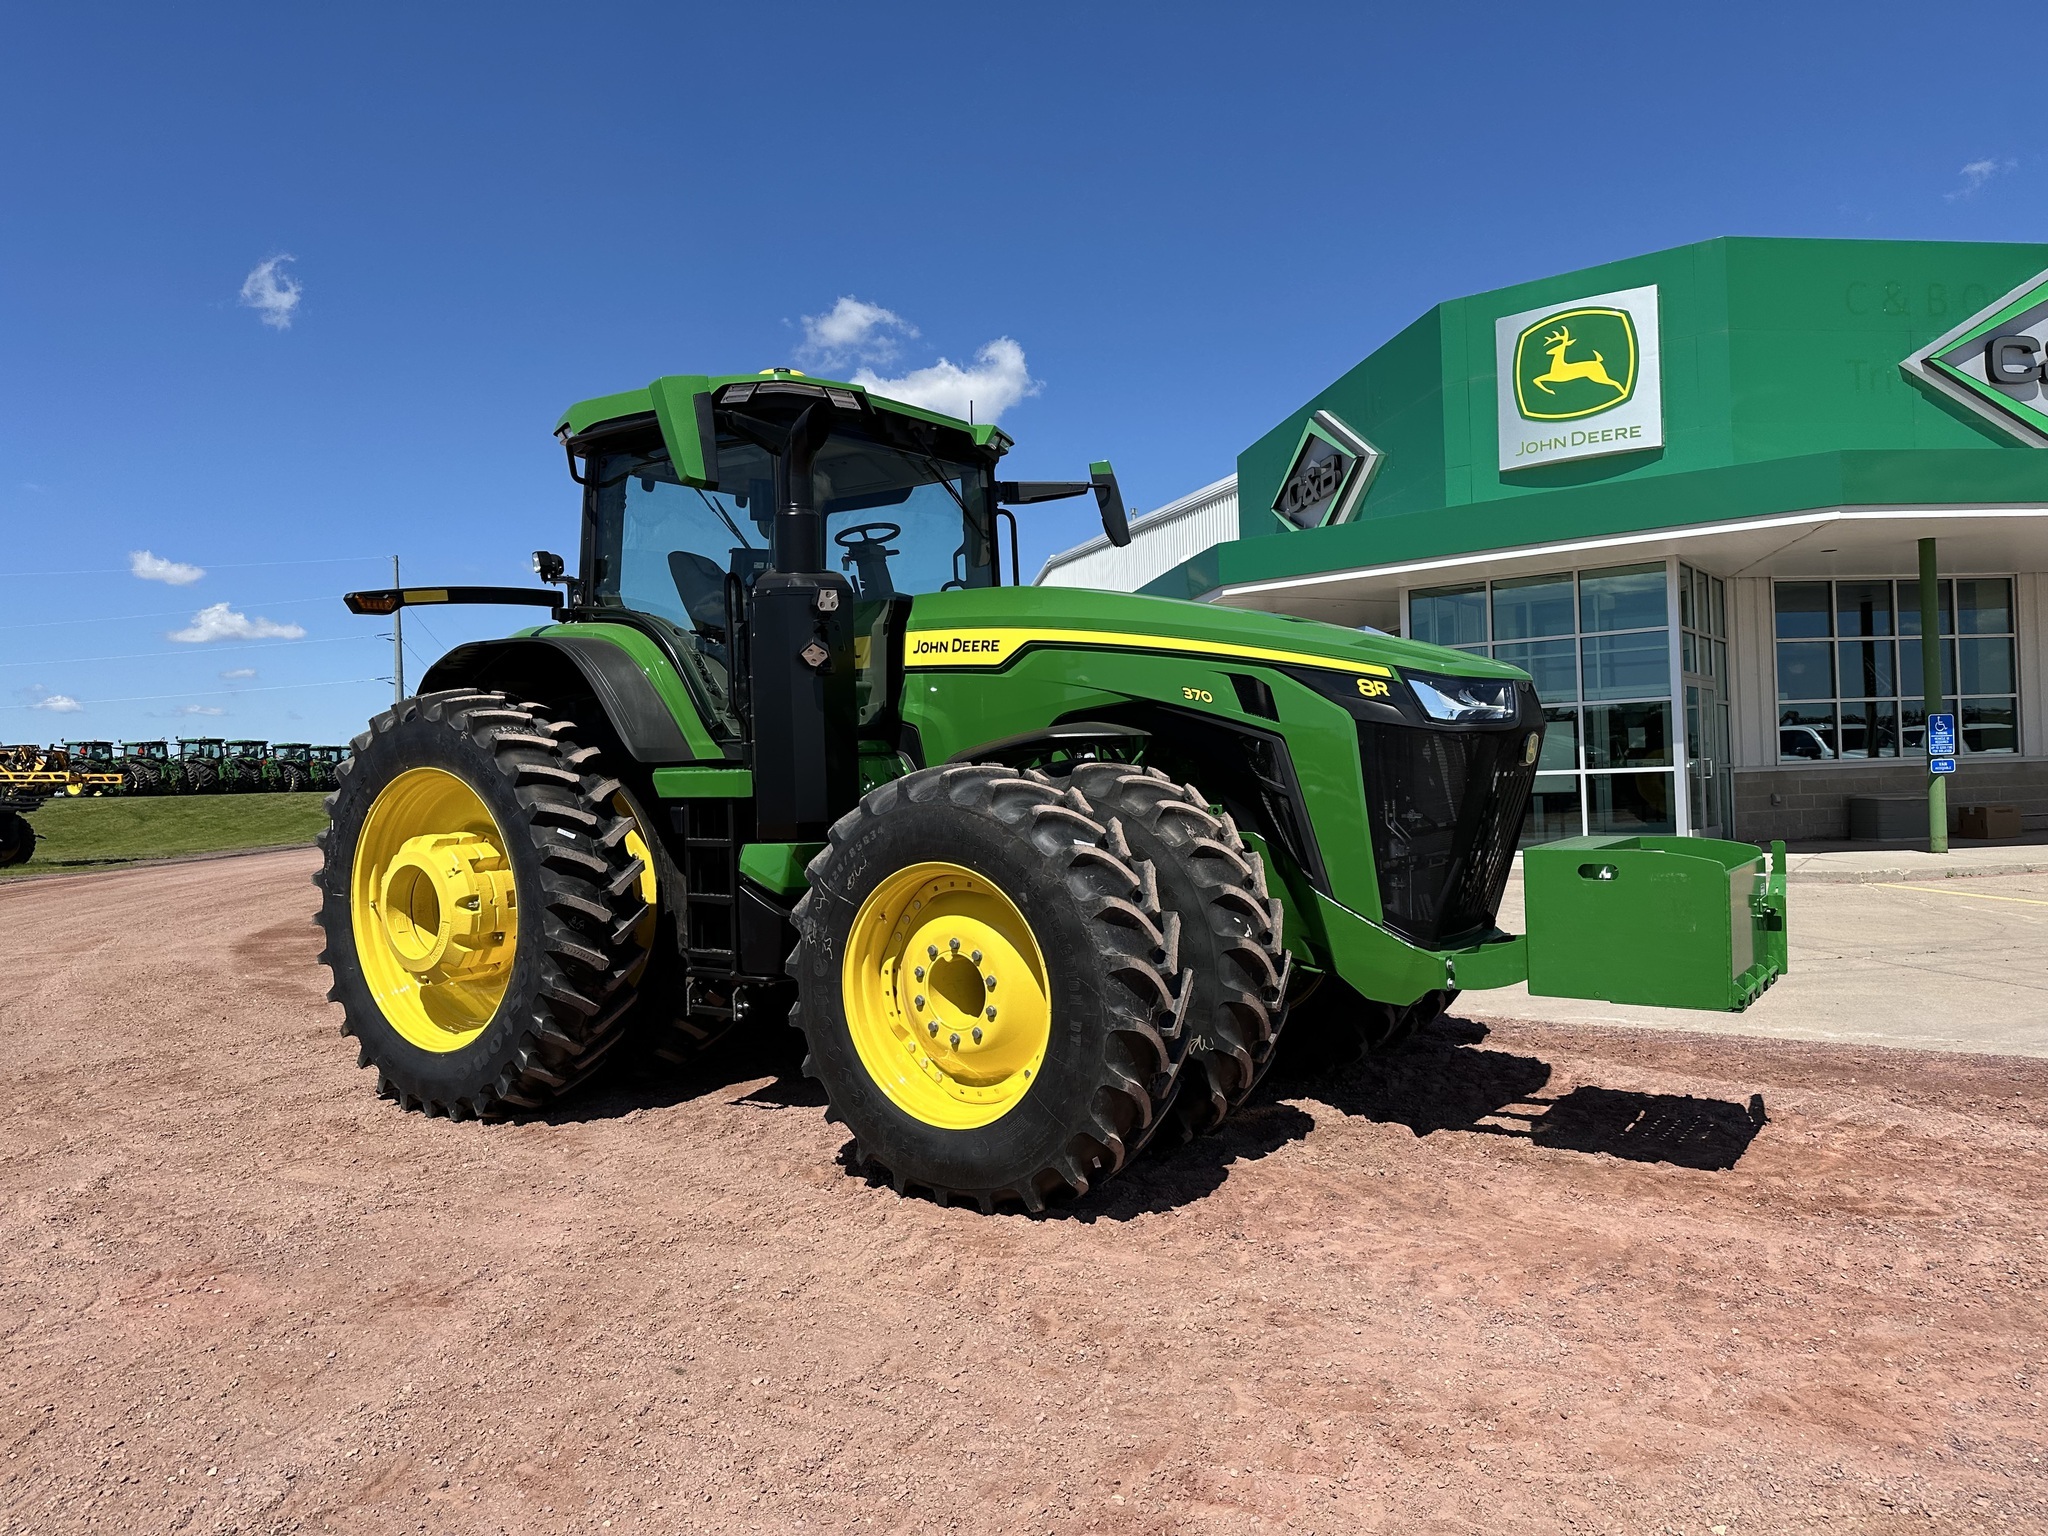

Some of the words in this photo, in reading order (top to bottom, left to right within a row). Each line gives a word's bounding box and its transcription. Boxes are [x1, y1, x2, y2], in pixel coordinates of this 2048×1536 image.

[1515, 436, 1566, 456] JOHN
[1571, 426, 1642, 446] DEERE
[1287, 453, 1341, 513] C&B
[913, 640, 948, 654] JOHN
[952, 638, 1000, 653] DEERE
[1181, 687, 1213, 703] 370
[1356, 678, 1391, 697] 8R
[1045, 904, 1083, 1006] TRACTION
